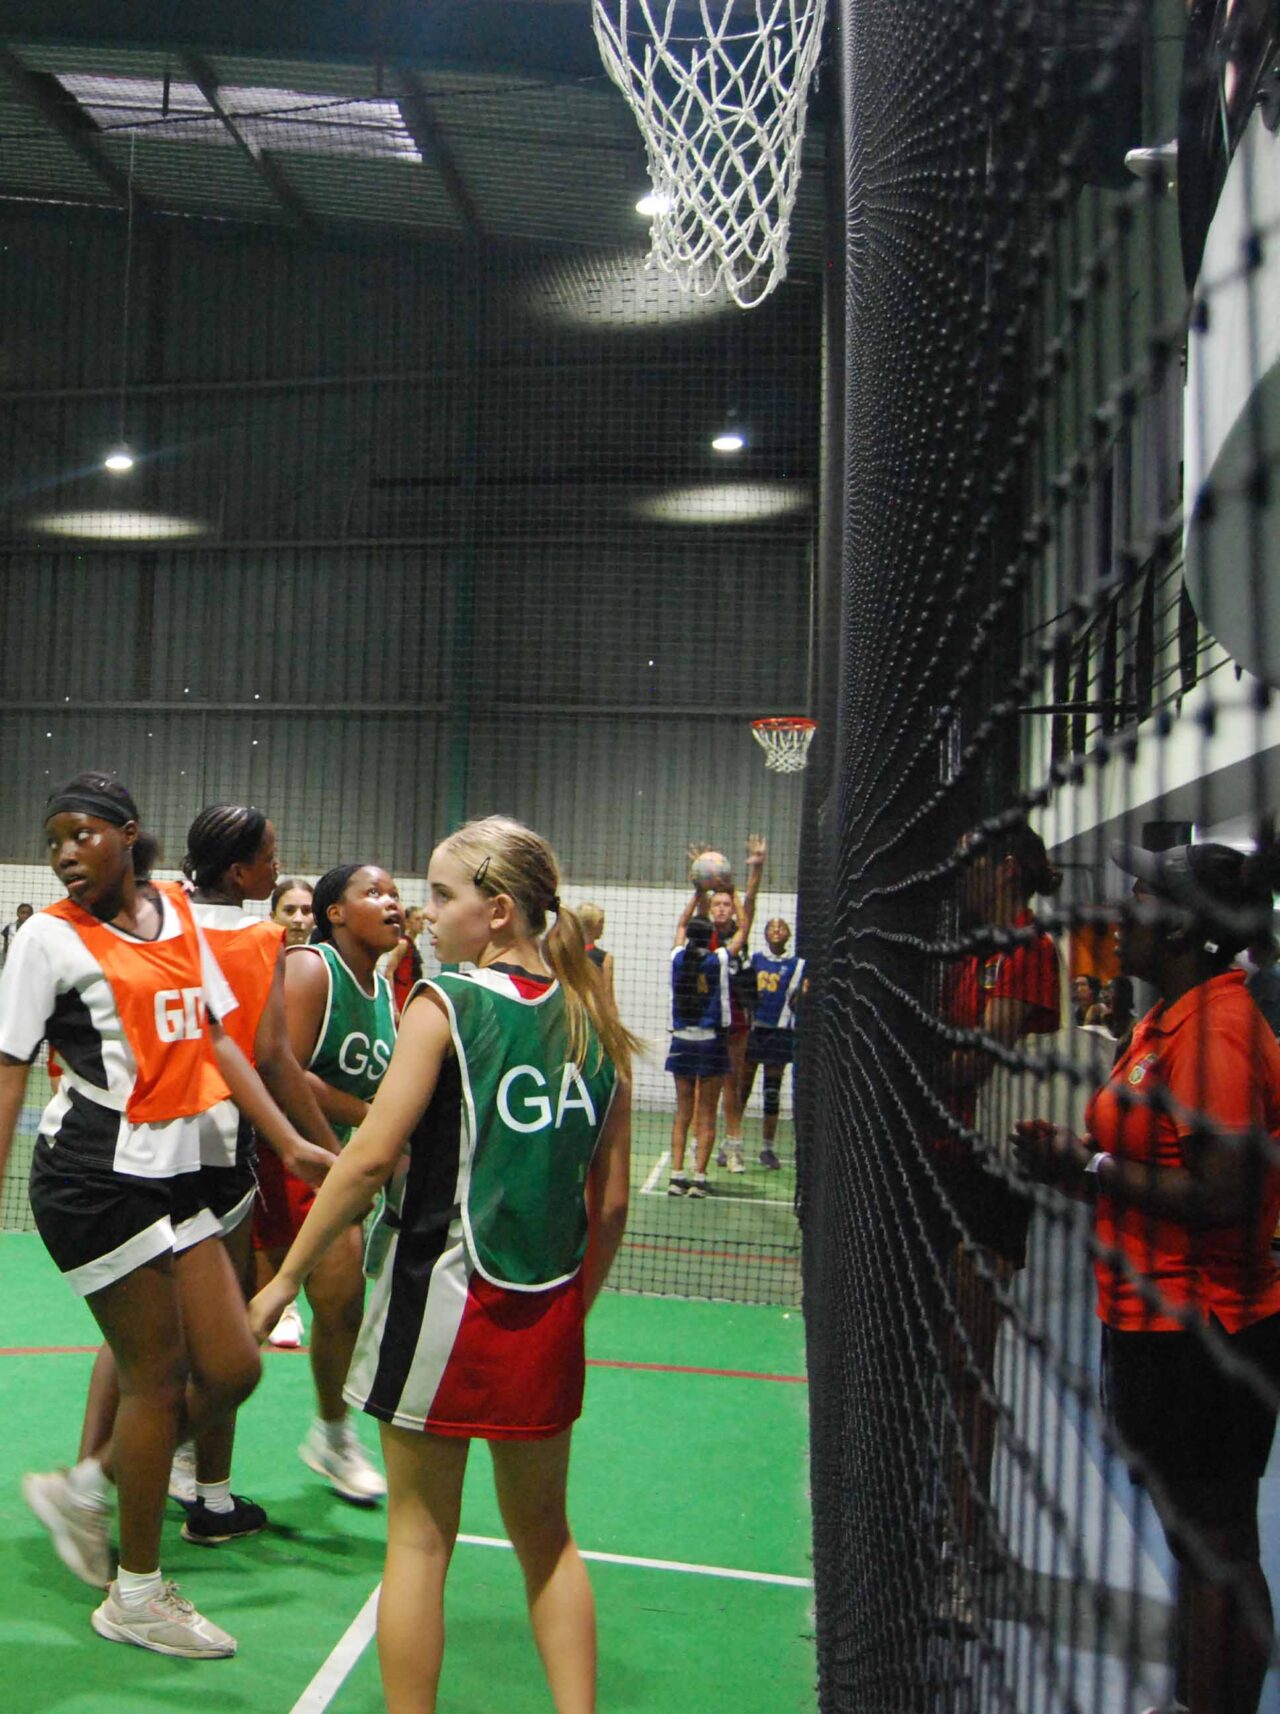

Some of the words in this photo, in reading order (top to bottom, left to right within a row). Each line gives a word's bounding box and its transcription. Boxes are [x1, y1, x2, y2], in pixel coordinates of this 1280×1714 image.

[757, 970, 780, 992] GS
[154, 987, 205, 1042] GD
[339, 1031, 390, 1080] GS
[497, 1062, 596, 1133] GA
